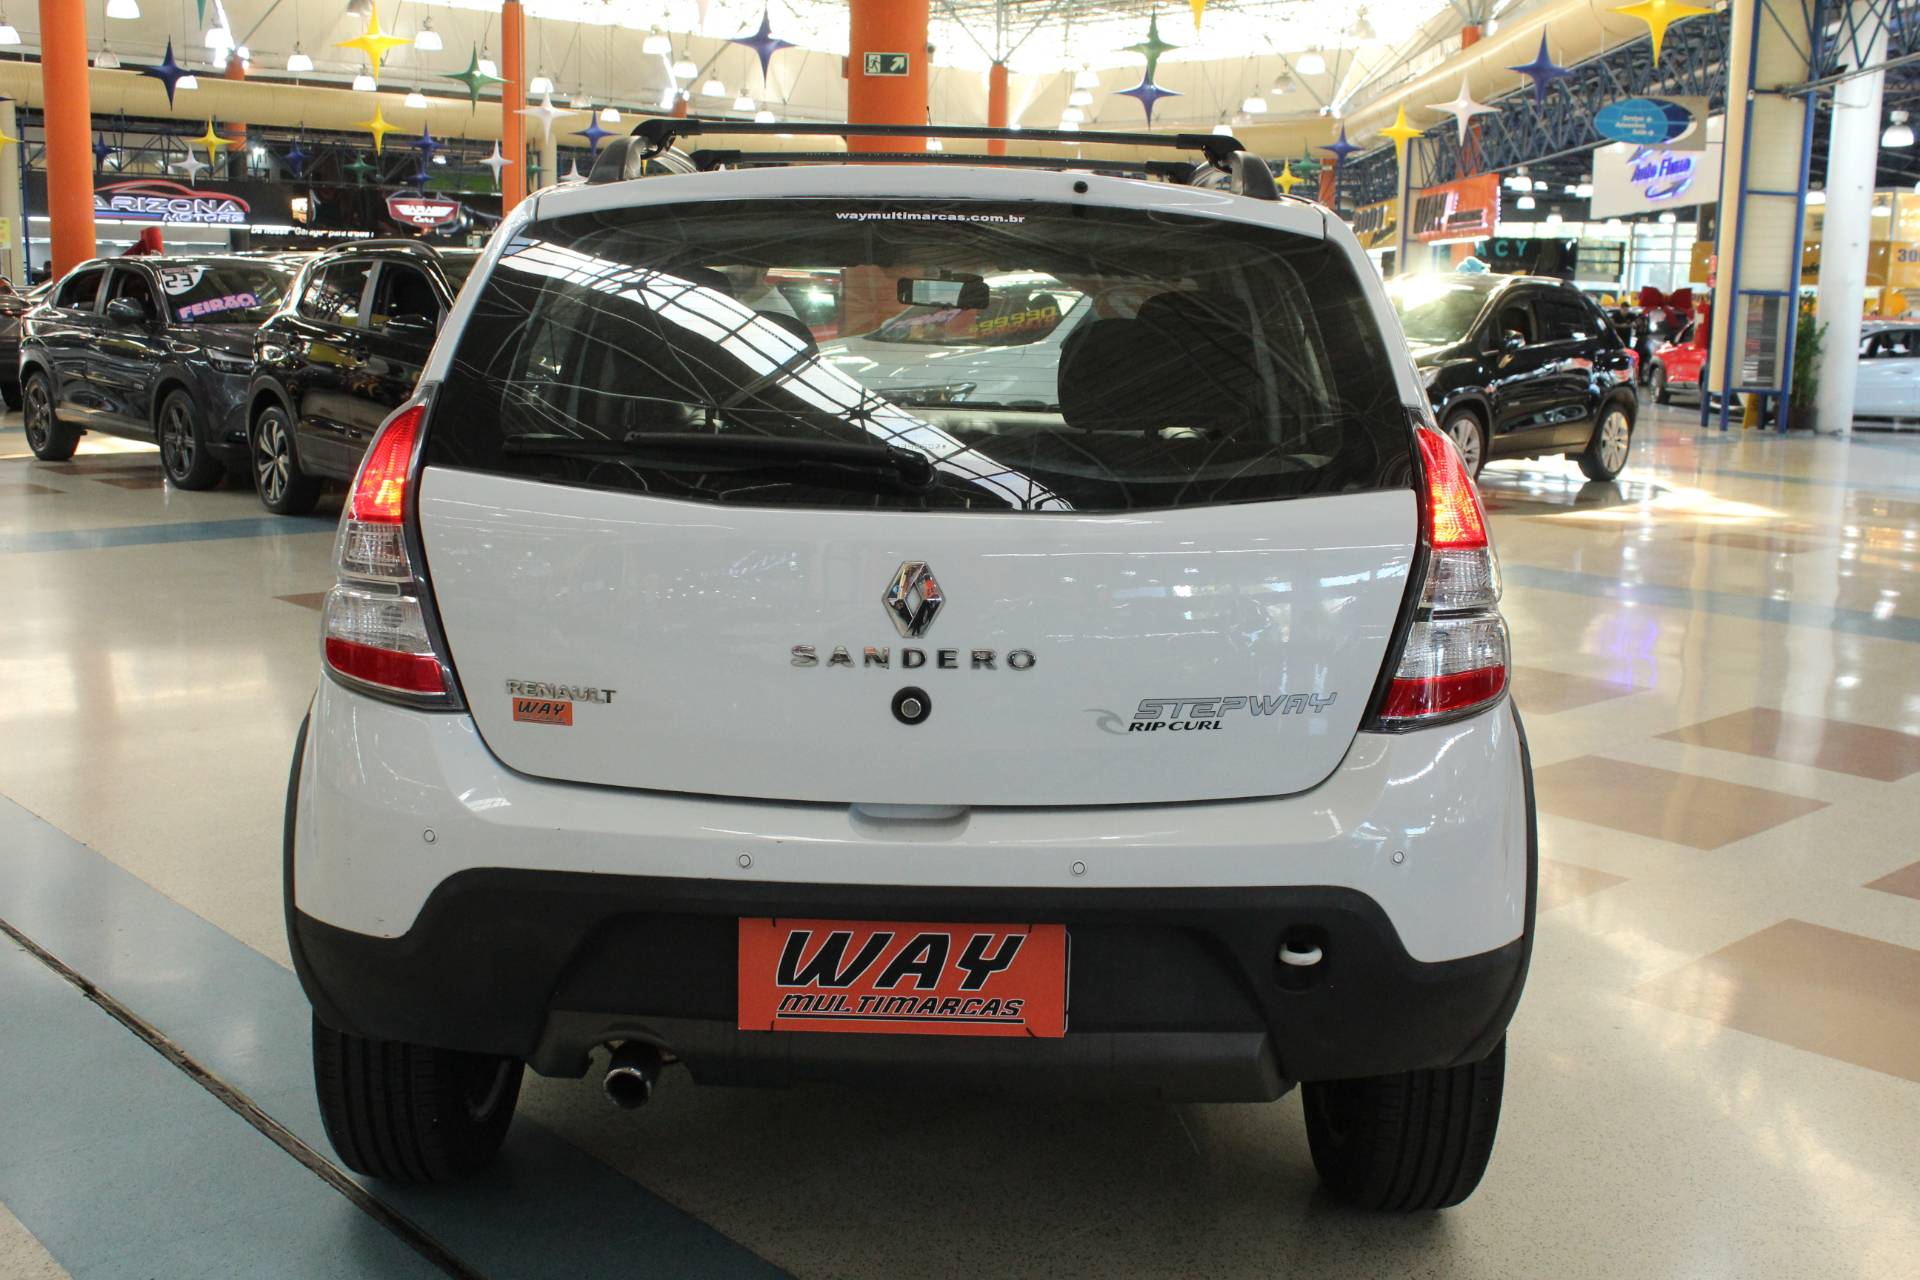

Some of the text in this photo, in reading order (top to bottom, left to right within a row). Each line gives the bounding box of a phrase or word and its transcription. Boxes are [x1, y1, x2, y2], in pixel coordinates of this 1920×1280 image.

[162, 213, 245, 222] MOTORS
[835, 211, 1026, 224] waymultimarcas.com.br
[1897, 248, 1920, 263] 30
[164, 273, 194, 288] 23
[790, 644, 1037, 670] SANDERO
[505, 679, 617, 704] RENAULT
[518, 701, 566, 715] WAY
[1133, 692, 1338, 720] STEPWAY
[775, 929, 1027, 991] WAY
[776, 994, 1025, 1017] MULTIMARCAS
